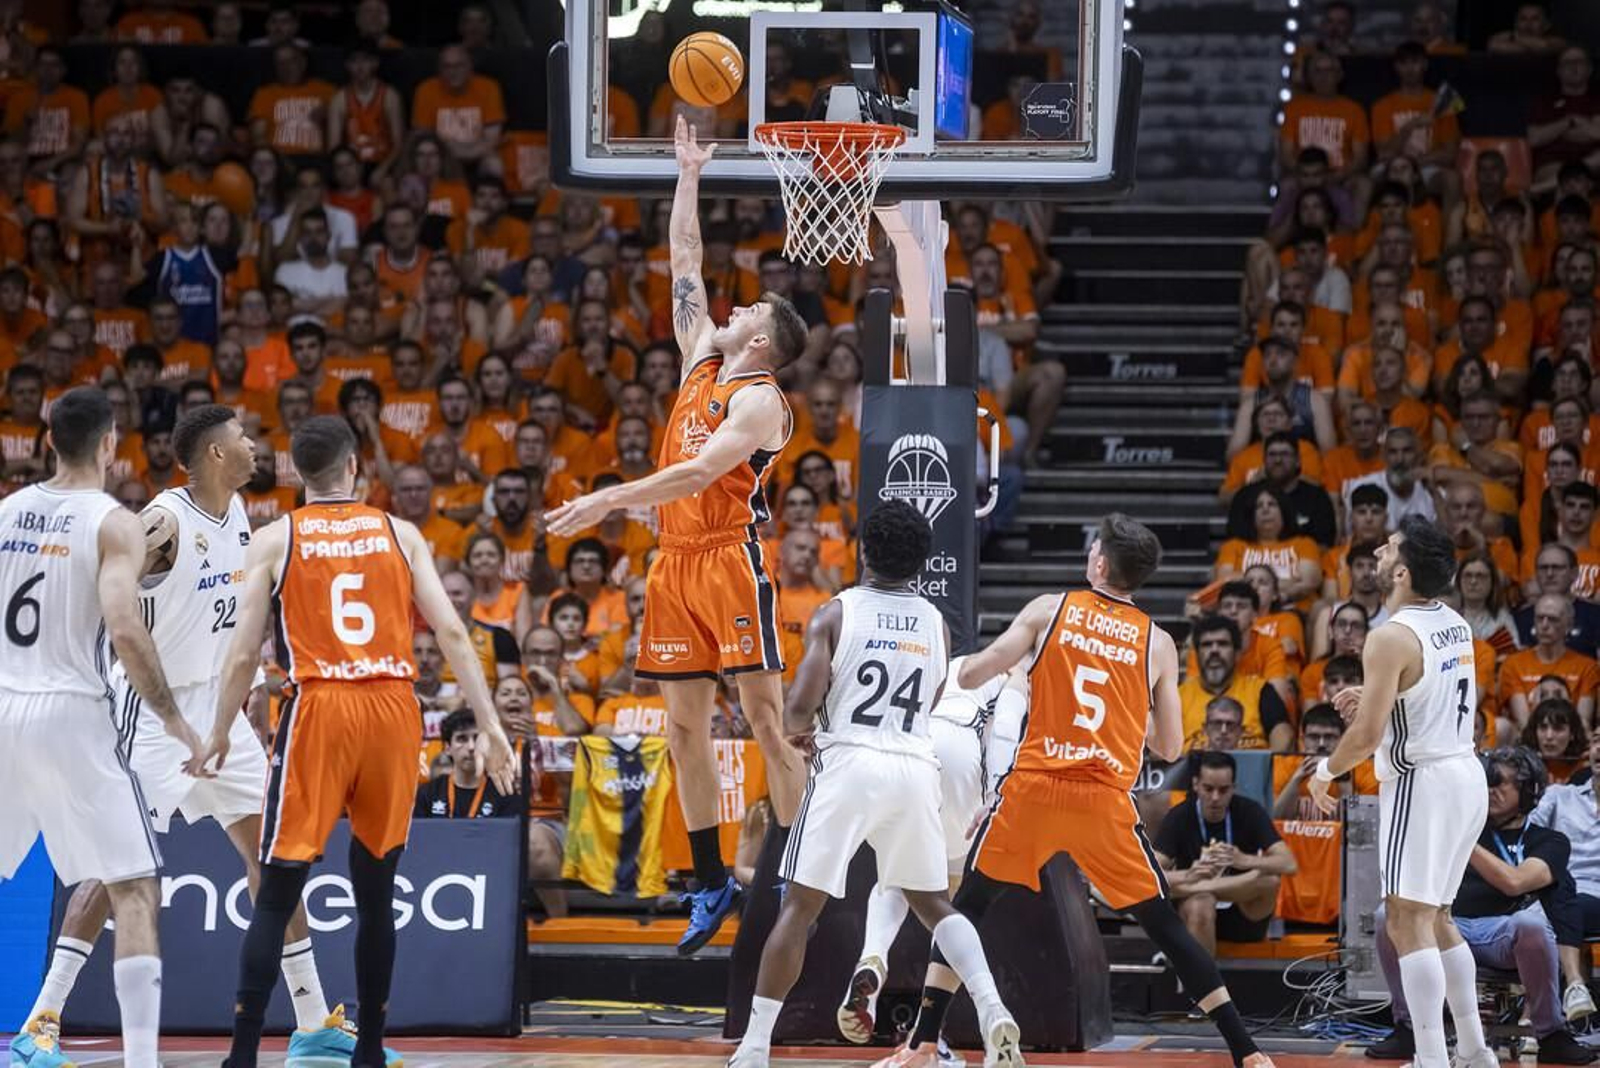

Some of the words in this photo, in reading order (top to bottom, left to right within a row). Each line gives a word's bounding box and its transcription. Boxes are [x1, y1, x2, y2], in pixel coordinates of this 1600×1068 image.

[1108, 354, 1178, 379] Torres
[1103, 436, 1174, 463] Torres
[884, 489, 921, 497] VALENCIA
[923, 489, 952, 497] BASKET
[300, 536, 391, 560] PAMESA
[5, 571, 45, 648] 6
[212, 596, 237, 633] 22
[331, 573, 376, 645] 6
[877, 613, 919, 633] FELIZ
[1064, 605, 1085, 626] DE
[1086, 613, 1139, 645] LARREA
[1058, 629, 1138, 666] PAMESA
[850, 659, 924, 733] 24
[1073, 664, 1110, 732] 5
